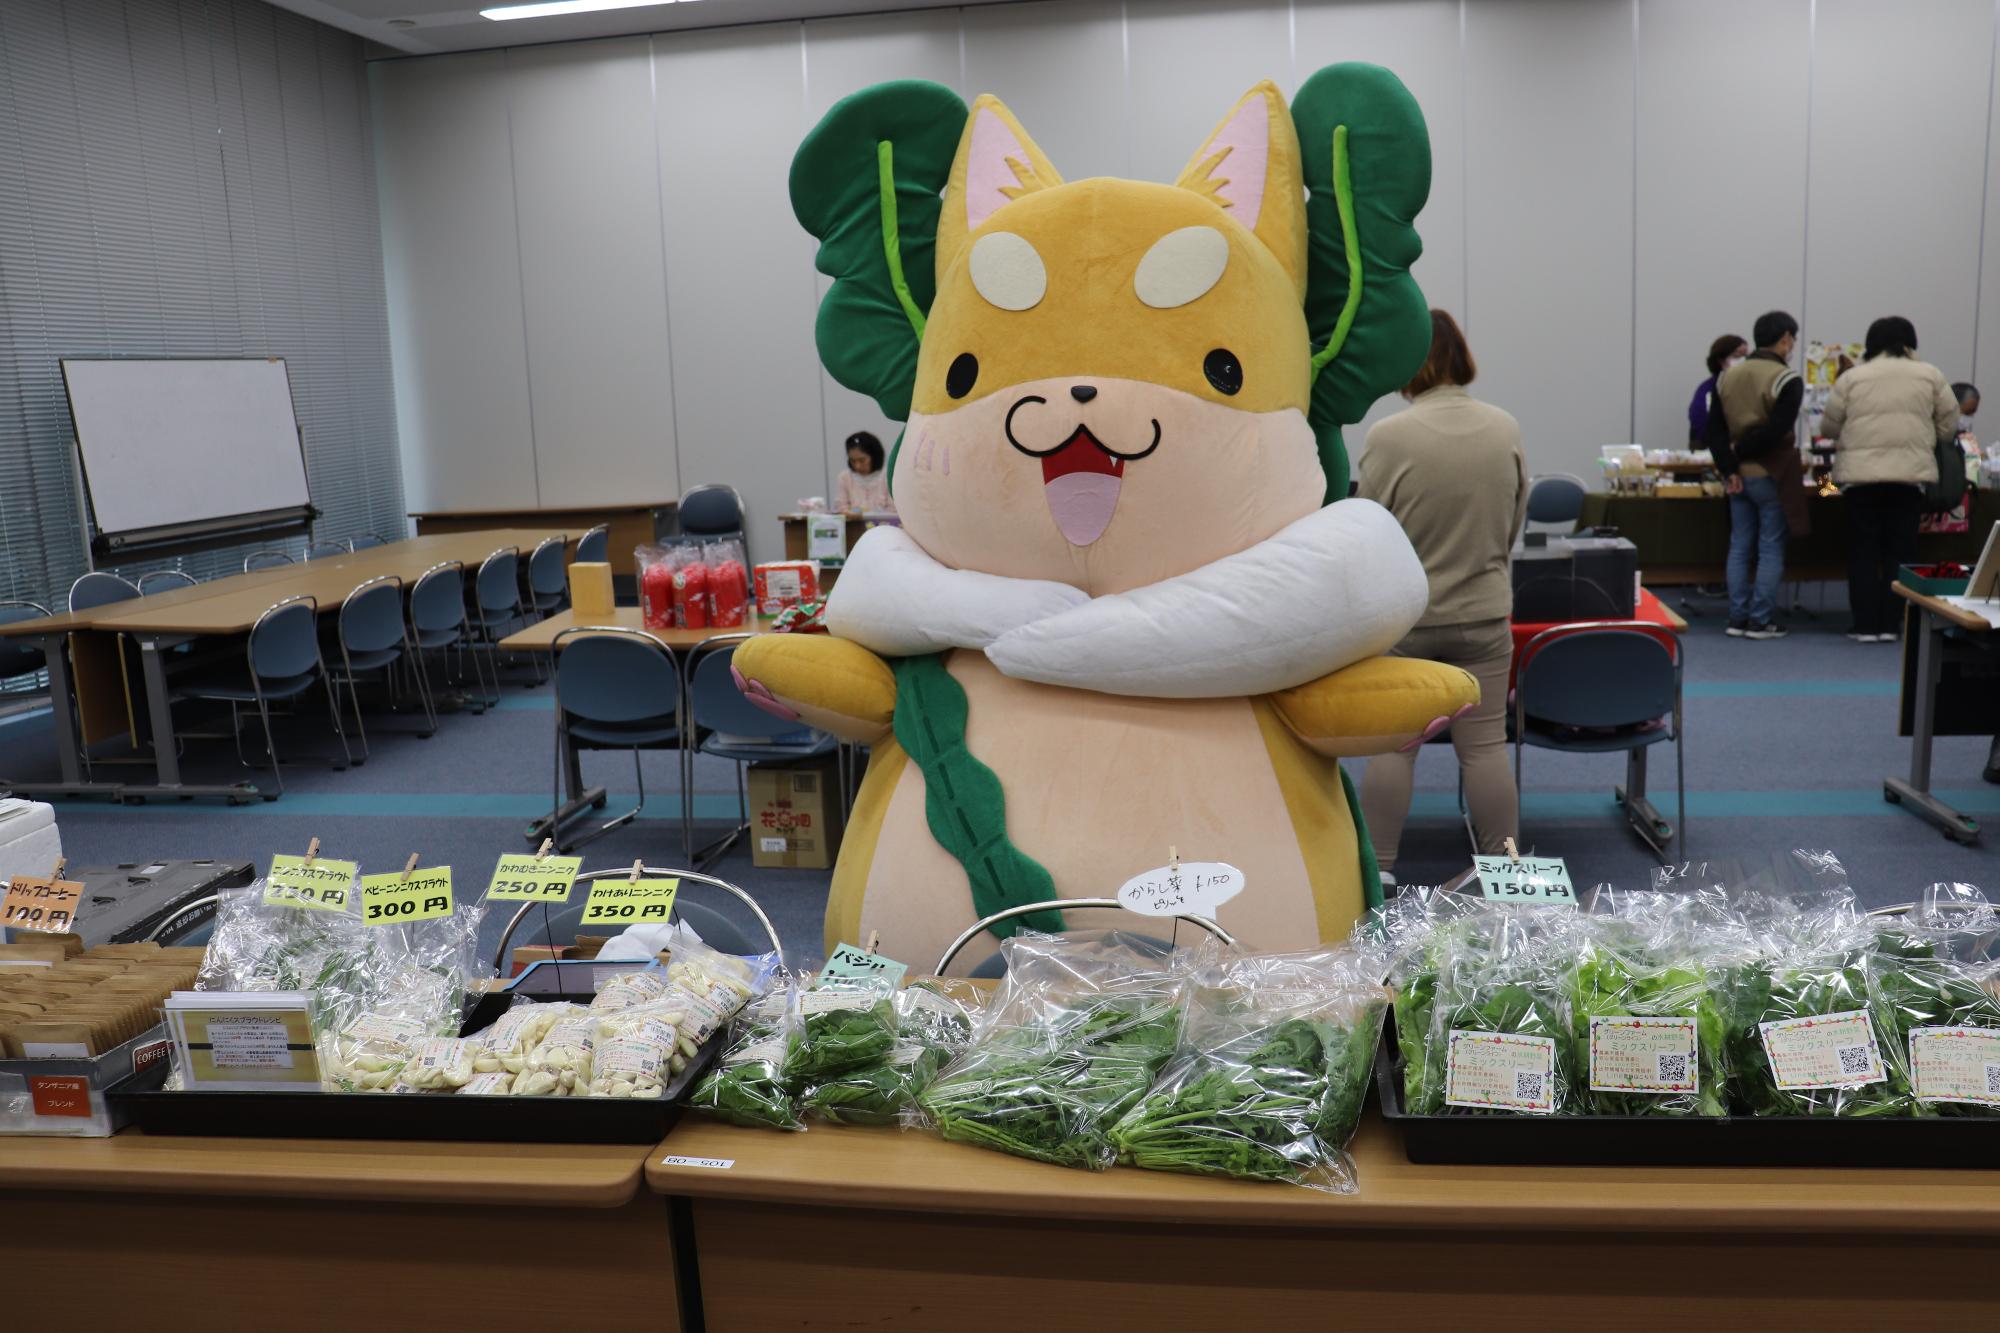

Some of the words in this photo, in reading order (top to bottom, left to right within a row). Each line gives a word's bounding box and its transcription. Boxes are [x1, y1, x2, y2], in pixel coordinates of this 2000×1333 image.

[500, 864, 575, 875] かわむきニンニク
[1479, 862, 1563, 875] ミックスリーフ
[494, 880, 567, 895] 250円
[593, 888, 673, 898] わけありニンニク
[1490, 882, 1569, 897] 150円
[368, 896, 448, 919] 300円
[588, 904, 667, 918] 350円
[5, 905, 69, 925] 100円
[1611, 1041, 1676, 1052] ミックスリーフ
[1788, 1037, 1854, 1052] ミックスリーフ
[136, 1048, 167, 1065] COFFEE
[1470, 1056, 1534, 1069] ミックスリーフ
